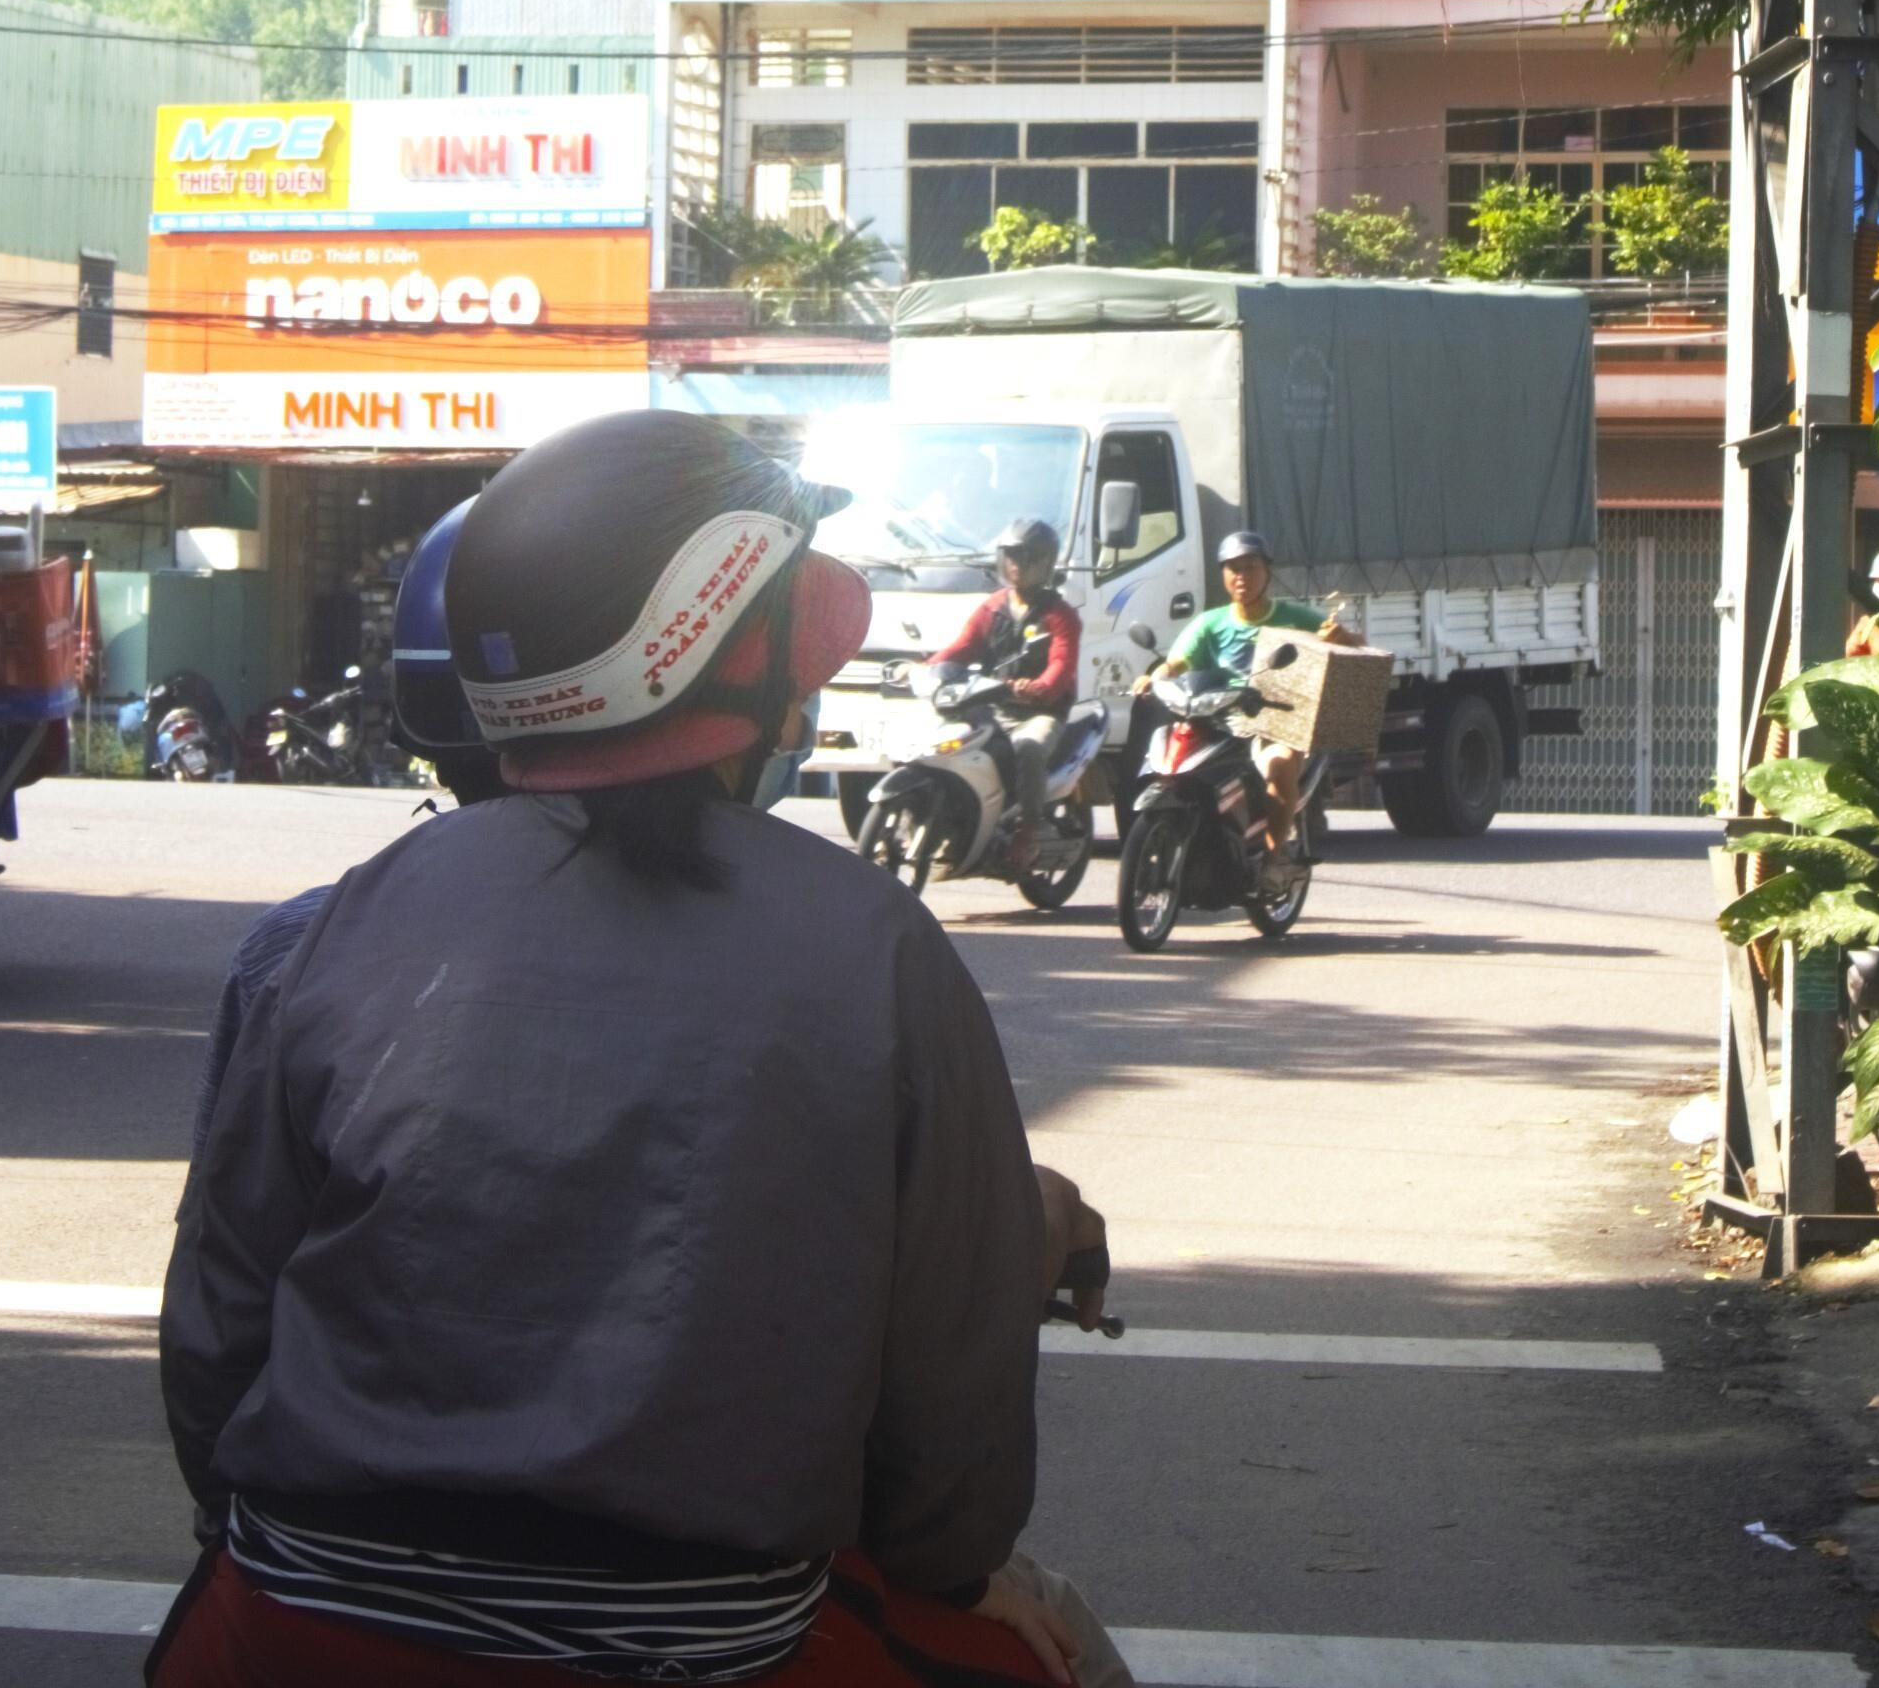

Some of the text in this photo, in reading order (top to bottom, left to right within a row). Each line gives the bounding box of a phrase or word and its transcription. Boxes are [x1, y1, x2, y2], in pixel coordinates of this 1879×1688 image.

[171, 116, 335, 162] MPE
[400, 132, 593, 176] MINH THI
[245, 269, 542, 329] nanoco
[283, 391, 402, 430] MINH
[420, 391, 496, 429] THI
[660, 610, 691, 639] TÔ
[695, 573, 723, 604] XE
[719, 530, 752, 575] MÁY
[710, 535, 770, 615] TRUNG
[513, 696, 607, 727] TRUNG
